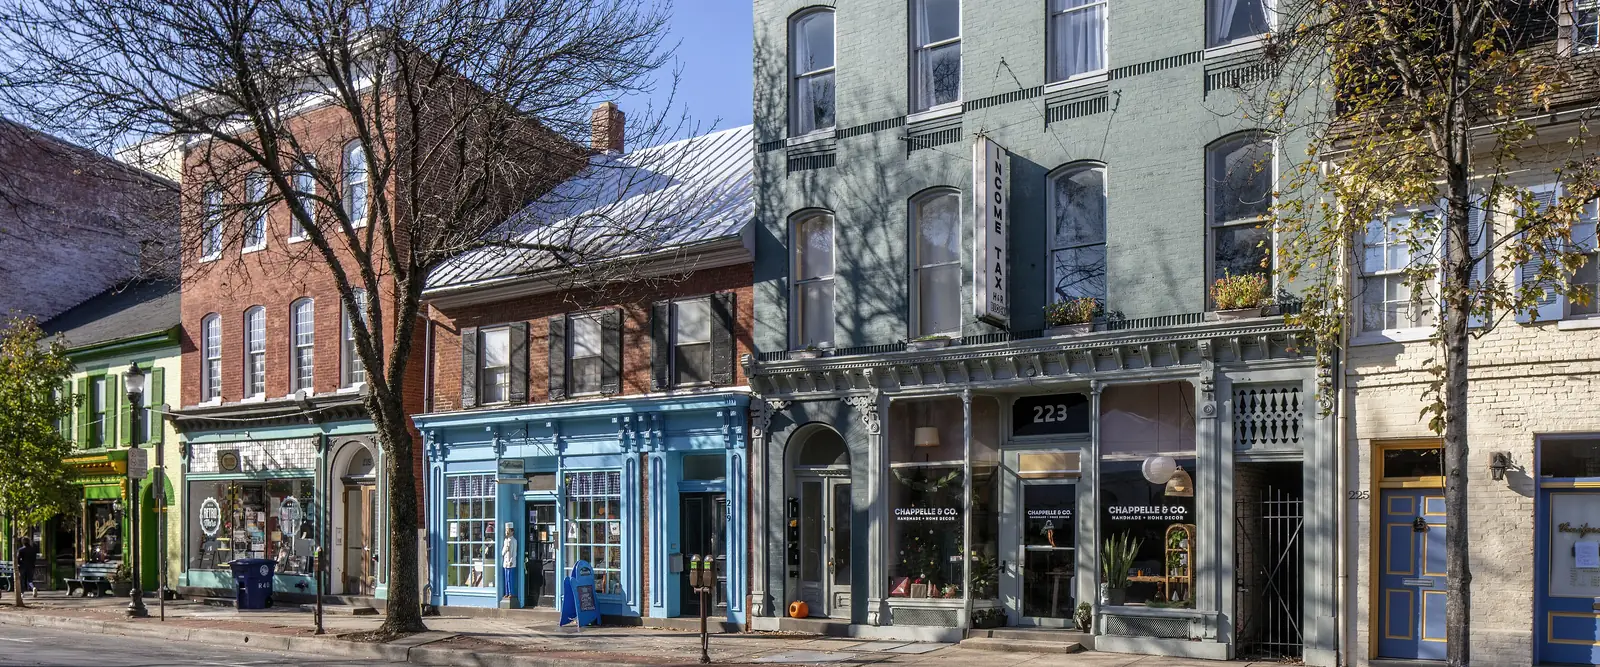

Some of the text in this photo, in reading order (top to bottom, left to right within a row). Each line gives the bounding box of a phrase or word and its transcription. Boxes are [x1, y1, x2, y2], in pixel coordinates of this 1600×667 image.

[994, 147, 1002, 290] INCOME TAX
[1033, 404, 1068, 423] 223
[1348, 490, 1370, 500] 225
[203, 507, 217, 519] RETRO
[894, 507, 958, 516] CHAPPELLE & CO.
[1108, 505, 1188, 514] CHAPPELLE & CO.
